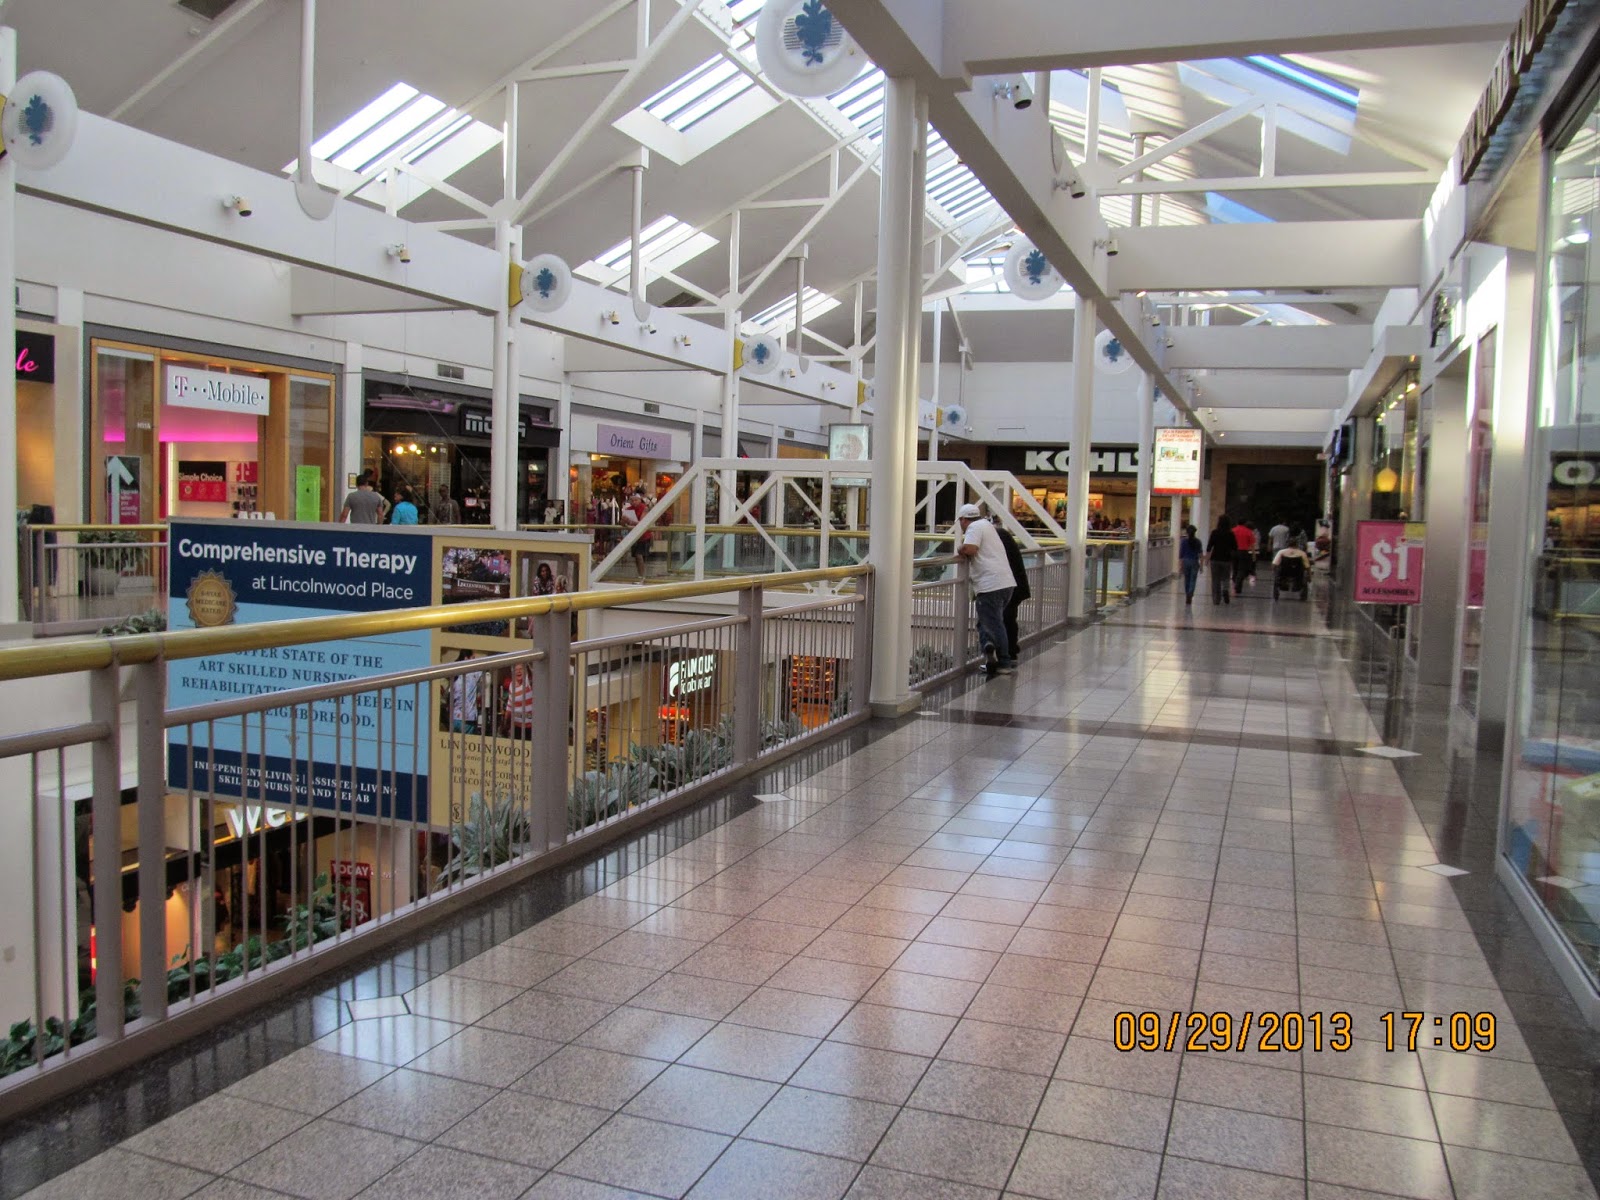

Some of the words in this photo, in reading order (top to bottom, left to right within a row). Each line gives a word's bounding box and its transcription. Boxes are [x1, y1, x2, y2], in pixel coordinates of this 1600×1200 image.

[610, 433, 634, 449] Orient
[640, 437, 658, 453] Gifts
[200, 473, 224, 482] Choice
[178, 538, 326, 566] Comprehensive
[332, 546, 417, 574] Therapy
[1370, 540, 1408, 582] $1
[252, 576, 266, 590] at
[270, 576, 366, 597] Lincolnwood
[372, 582, 414, 600] Place
[282, 648, 326, 664] STATE
[330, 652, 348, 665] OF
[353, 654, 383, 669] THE
[198, 660, 224, 672] ART
[228, 663, 288, 678] SKILLED
[398, 699, 414, 712] IN
[218, 774, 260, 788] SKILED
